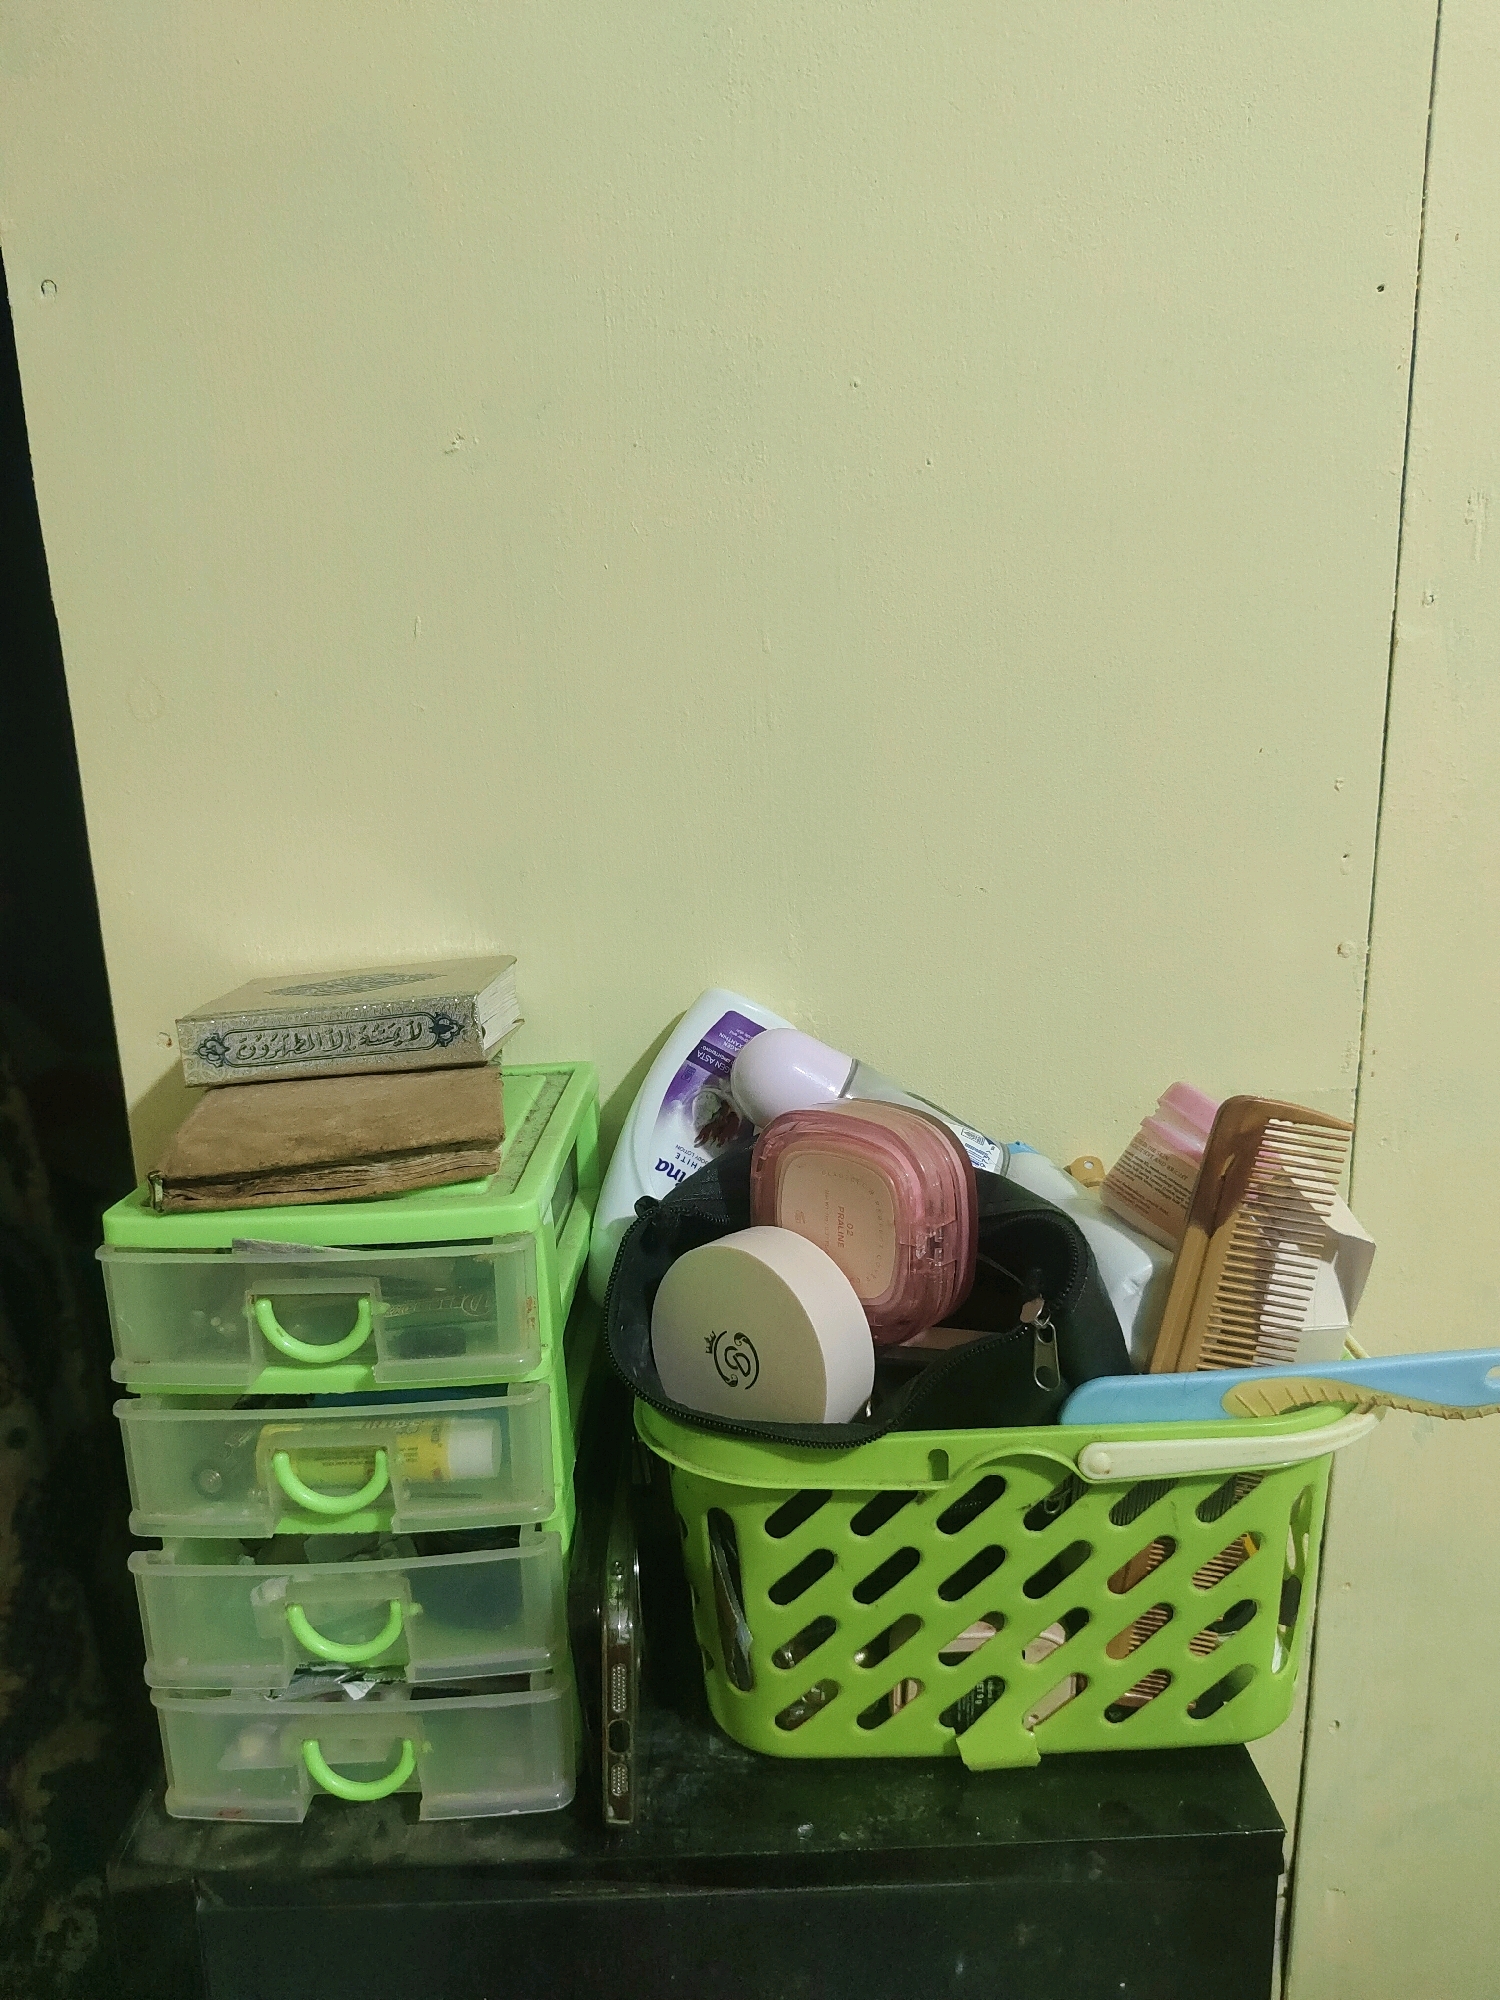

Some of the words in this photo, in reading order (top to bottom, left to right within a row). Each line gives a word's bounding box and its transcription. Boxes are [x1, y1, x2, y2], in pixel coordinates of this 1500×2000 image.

[697, 1050, 716, 1065] ASTA
[675, 1152, 702, 1170] HITE
[837, 1205, 845, 1249] PRALINE
[846, 1222, 854, 1237] 02
